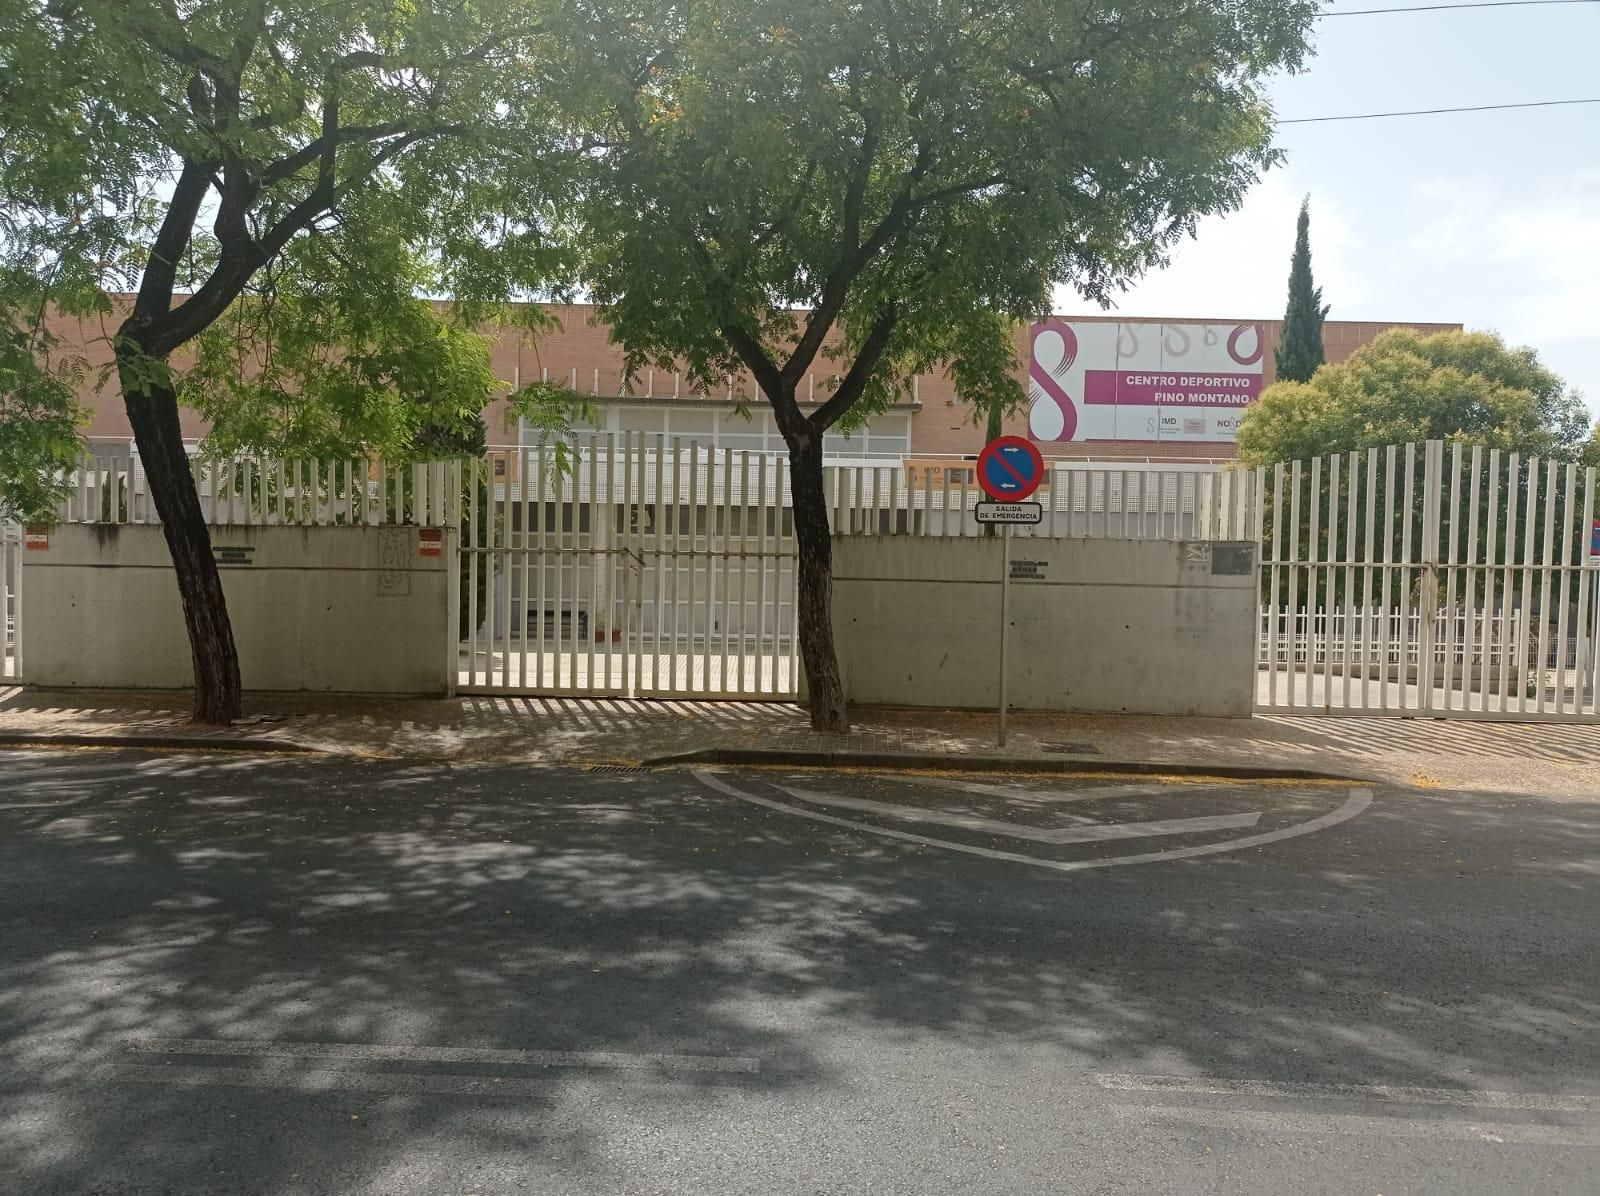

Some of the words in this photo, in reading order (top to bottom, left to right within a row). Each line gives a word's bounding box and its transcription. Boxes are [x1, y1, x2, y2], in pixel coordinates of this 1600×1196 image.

[1126, 375, 1177, 386] CENTRO
[1180, 376, 1250, 387] DEPORTIVO
[1154, 392, 1185, 402] PINO
[1188, 393, 1250, 404] MONTANO
